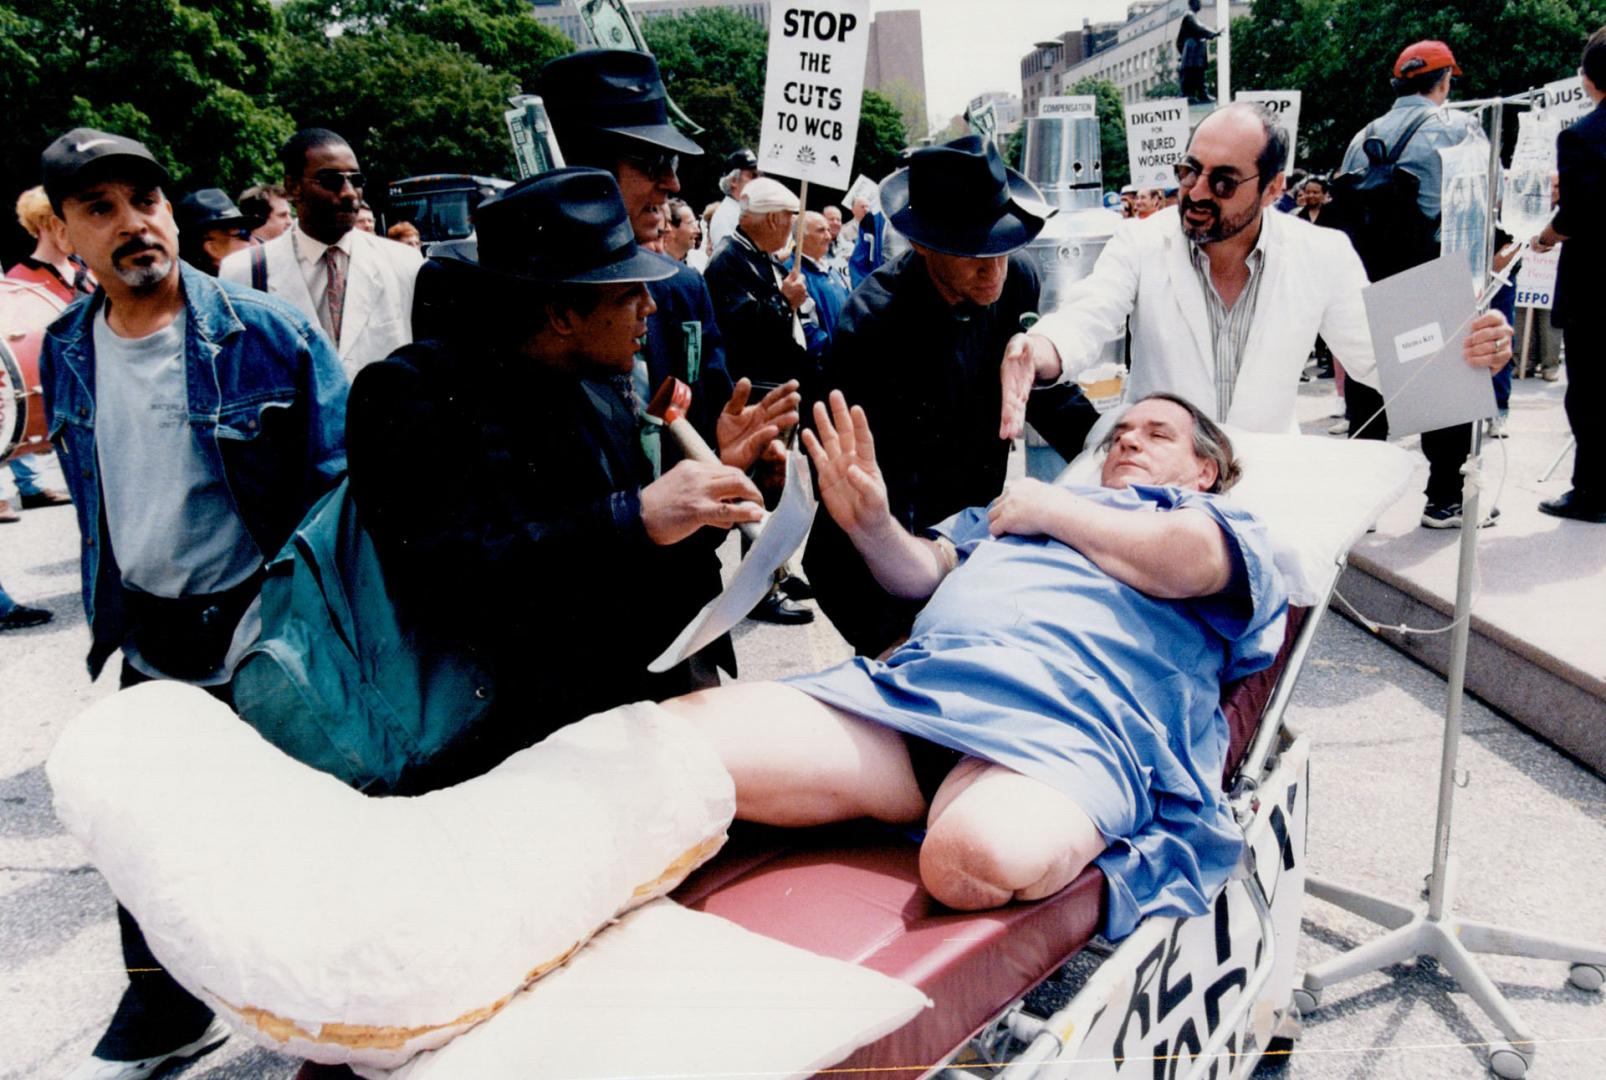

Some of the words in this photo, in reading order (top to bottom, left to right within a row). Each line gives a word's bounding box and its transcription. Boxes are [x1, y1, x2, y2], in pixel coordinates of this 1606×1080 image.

[783, 9, 857, 42] STOP
[799, 51, 832, 74] THE
[783, 81, 842, 110] CUTS
[1042, 103, 1092, 114] COMPENSATION
[1131, 108, 1183, 125] DIGNITY
[777, 112, 798, 132] TO
[804, 117, 843, 141] WCB
[1151, 126, 1163, 134] FOR
[1141, 137, 1176, 152] INJURED
[1517, 291, 1550, 304] EFPO
